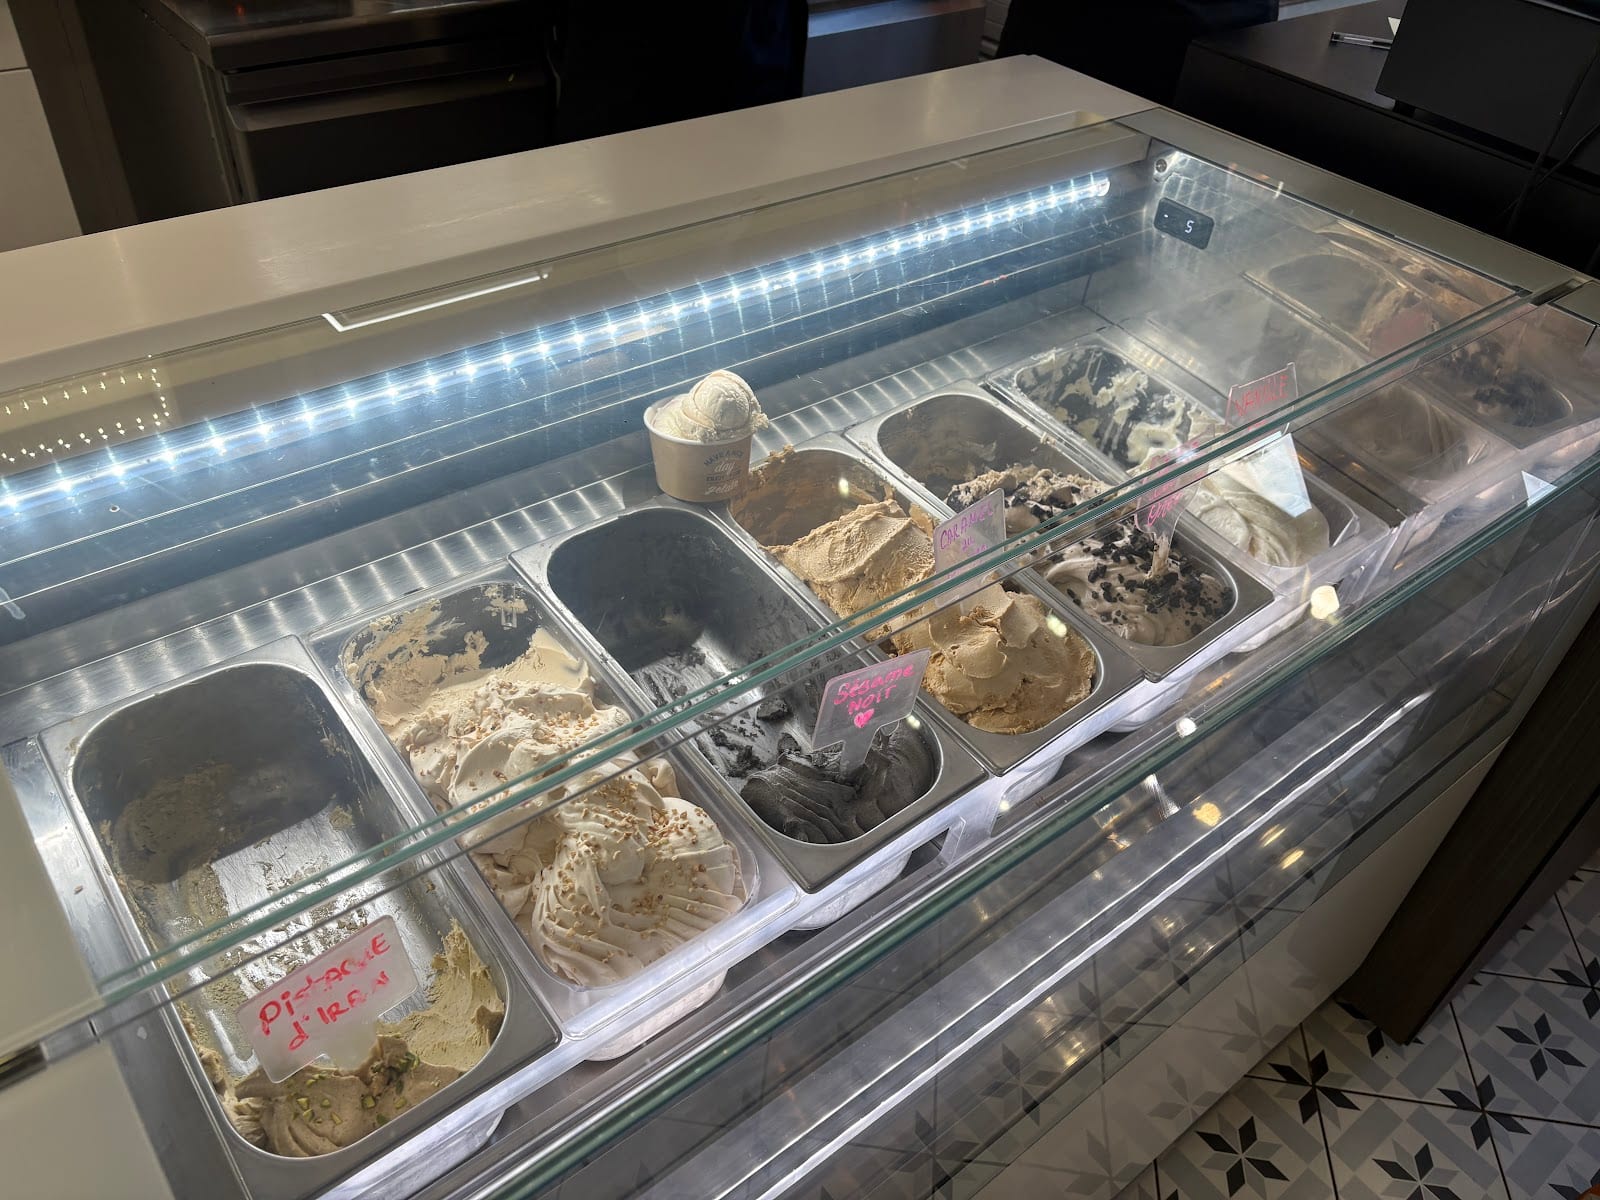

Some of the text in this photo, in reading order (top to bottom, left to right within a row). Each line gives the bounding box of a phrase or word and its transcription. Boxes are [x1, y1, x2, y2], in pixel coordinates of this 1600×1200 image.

[1184, 219, 1195, 234] 5
[714, 460, 736, 476] day
[940, 501, 994, 550] CARAMEL
